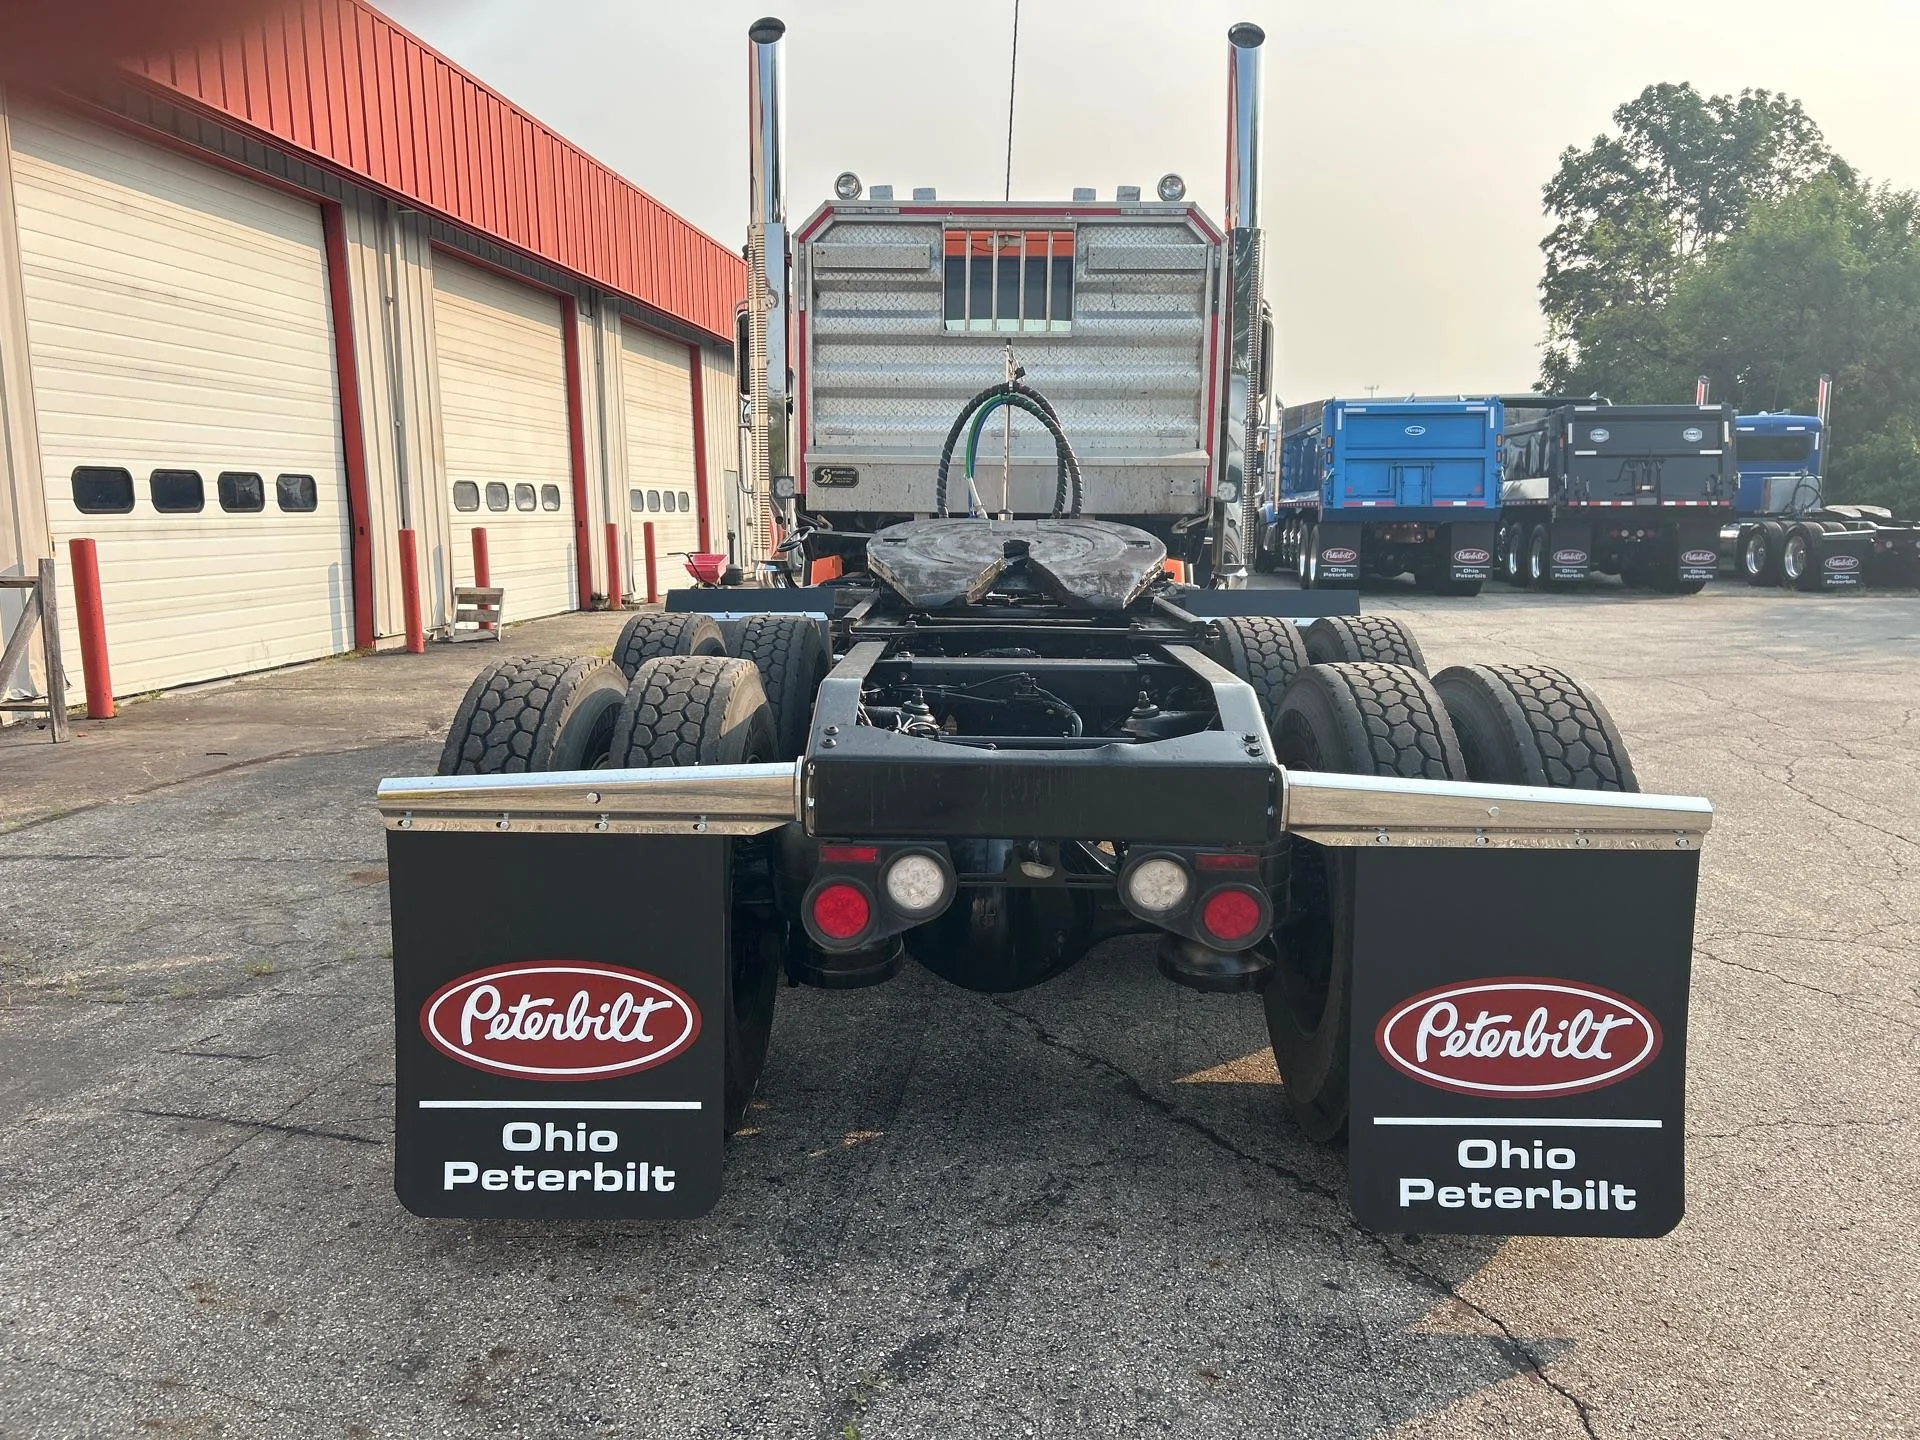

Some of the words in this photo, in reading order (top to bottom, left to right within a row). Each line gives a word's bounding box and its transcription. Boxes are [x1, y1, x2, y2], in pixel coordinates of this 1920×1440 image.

[460, 984, 674, 1046] Peterbilt
[1415, 1001, 1635, 1063] Peterbilt
[502, 1121, 619, 1152] Ohio
[1457, 1139, 1576, 1170] Ohio
[443, 1161, 676, 1192] Peterbilt
[1399, 1177, 1637, 1211] Peterbilt
